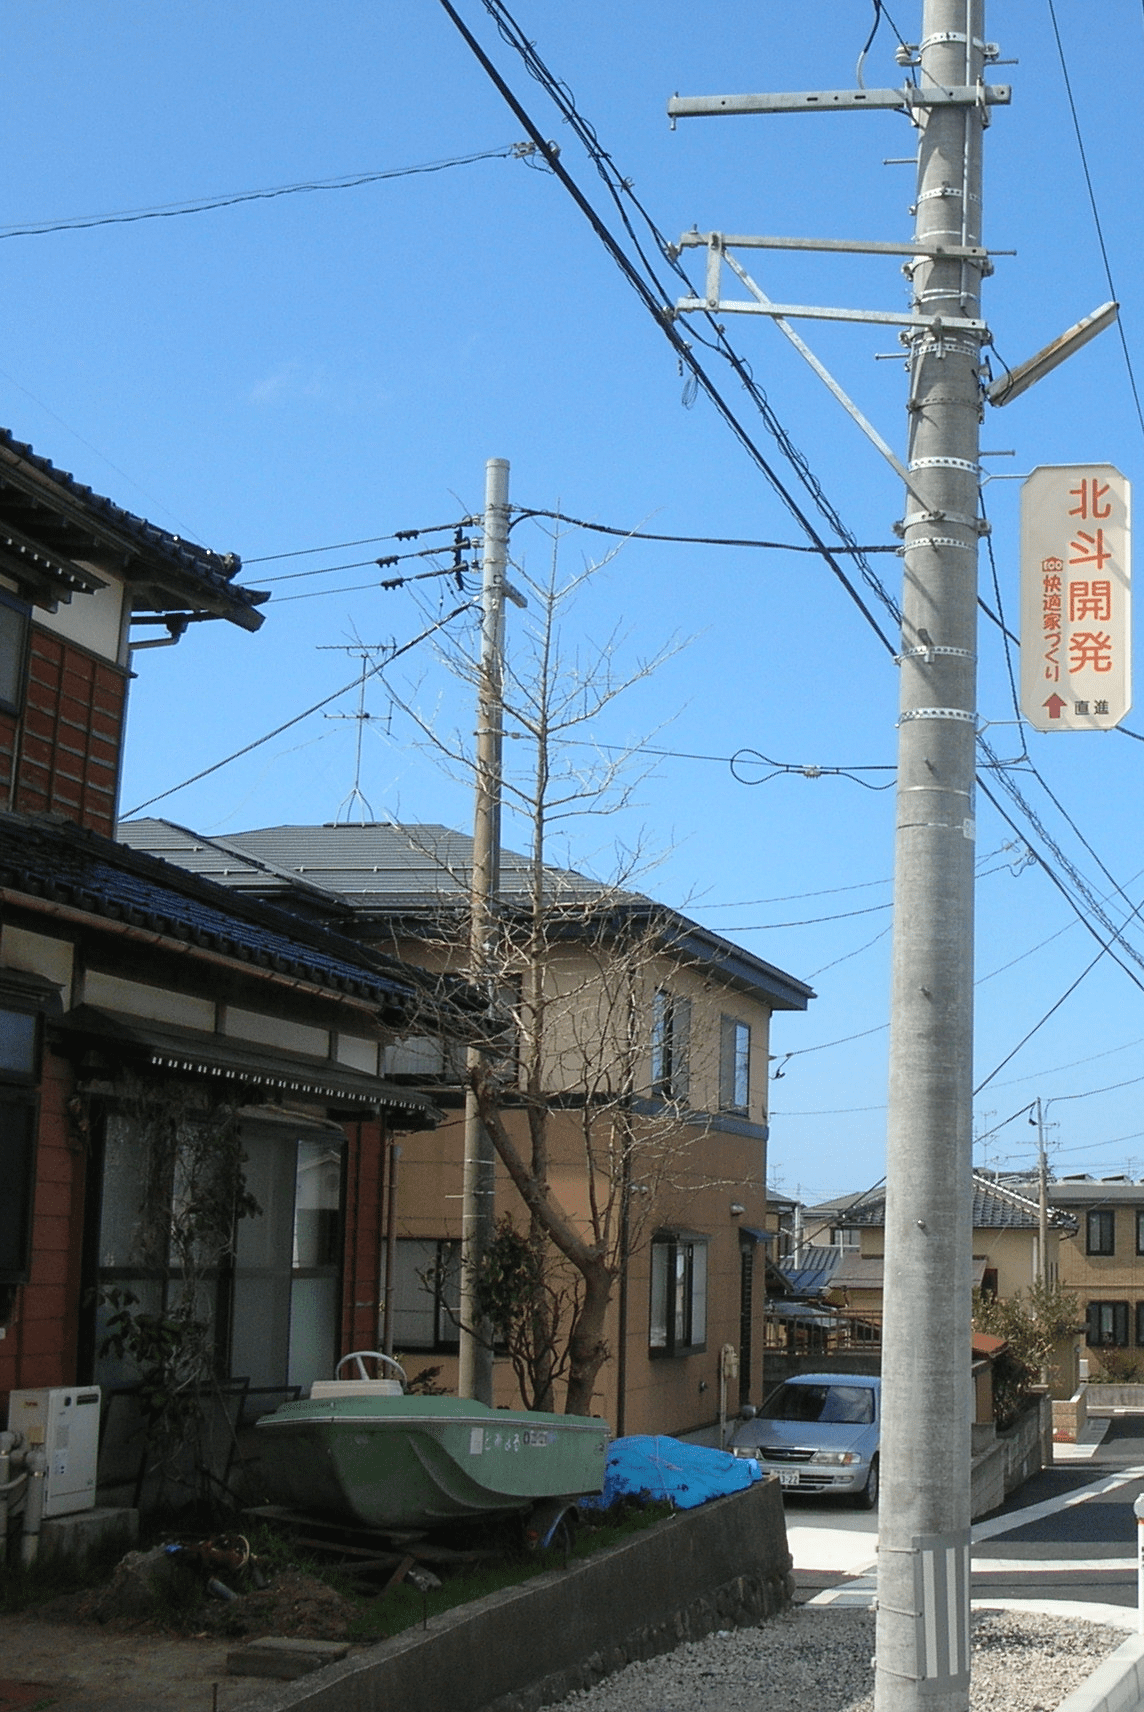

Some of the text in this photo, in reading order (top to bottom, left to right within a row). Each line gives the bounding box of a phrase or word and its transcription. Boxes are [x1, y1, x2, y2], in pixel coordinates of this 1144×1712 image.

[1042, 574, 1062, 682] 快適家づくり
[1068, 478, 1112, 674] 北斗開発
[1074, 700, 1110, 716] 直進
